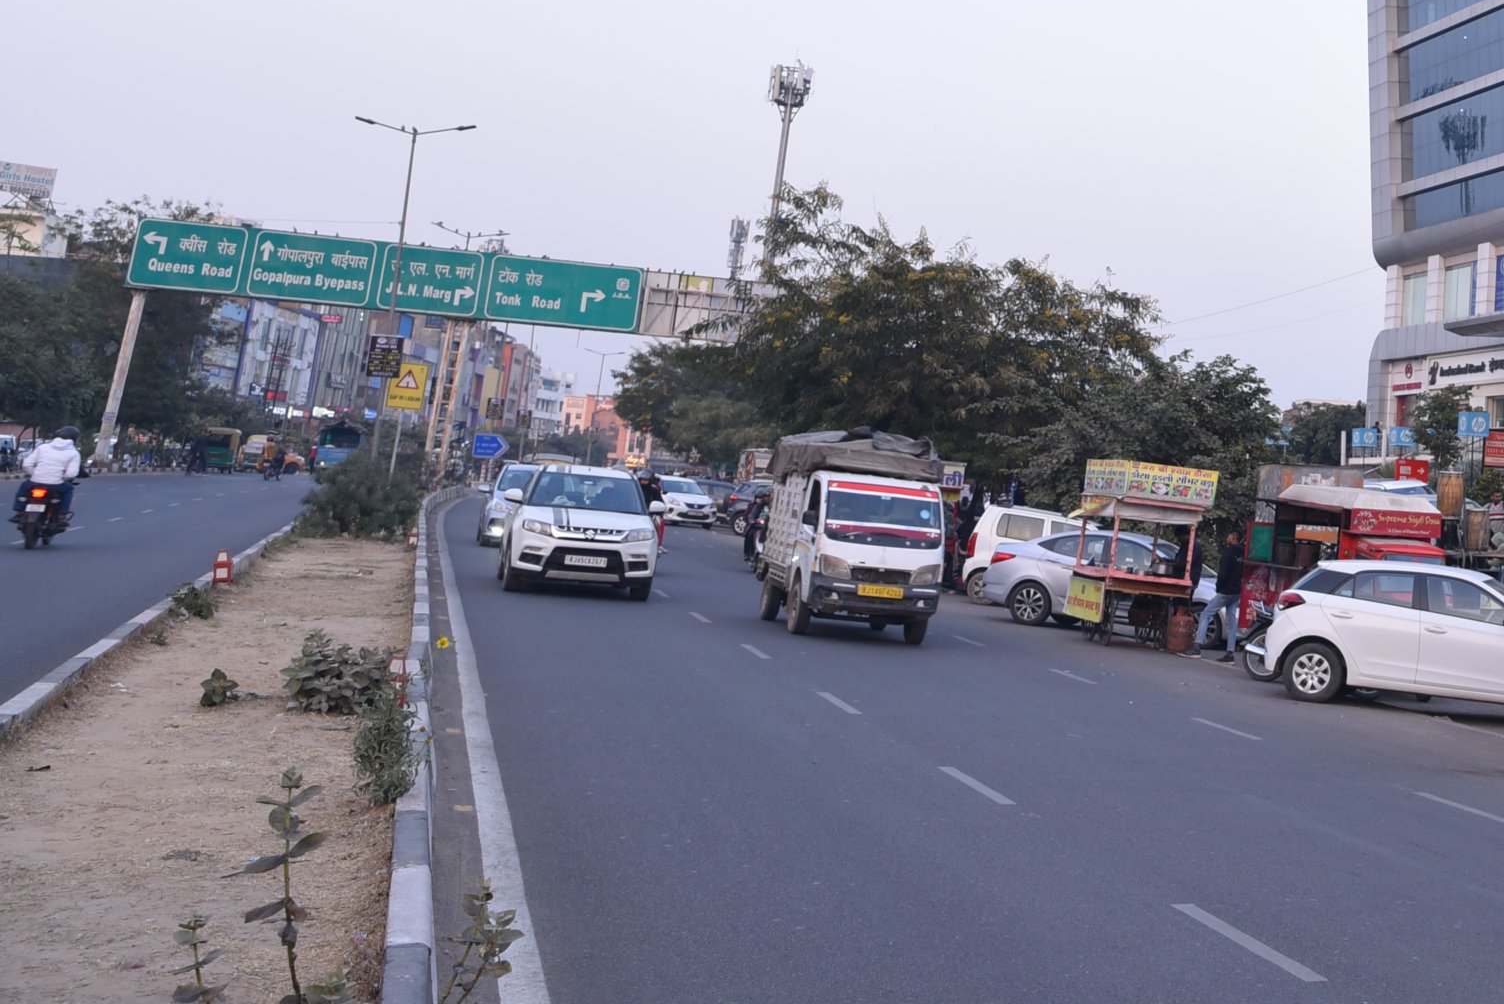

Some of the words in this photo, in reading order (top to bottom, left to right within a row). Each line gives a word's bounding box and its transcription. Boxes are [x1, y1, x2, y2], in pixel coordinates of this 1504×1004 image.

[24, 175, 54, 186] Hostel
[217, 237, 237, 255] रोड
[277, 244, 325, 269] गोपालपुरा
[331, 250, 368, 270] बाईपास
[148, 258, 195, 275] Queens
[202, 263, 233, 278] Road
[410, 261, 428, 276] एल.
[435, 264, 452, 280] एन.
[455, 264, 476, 280] मार्ग
[253, 268, 312, 287] Gopalpura
[314, 274, 365, 292] Byepass
[525, 269, 544, 287] रोड
[423, 285, 452, 303] Marg
[495, 292, 521, 307] Tonk
[531, 297, 561, 311] Road
[1468, 361, 1485, 373] Bank
[1378, 513, 1407, 525] Supreme
[1425, 516, 1441, 524] Dosa
